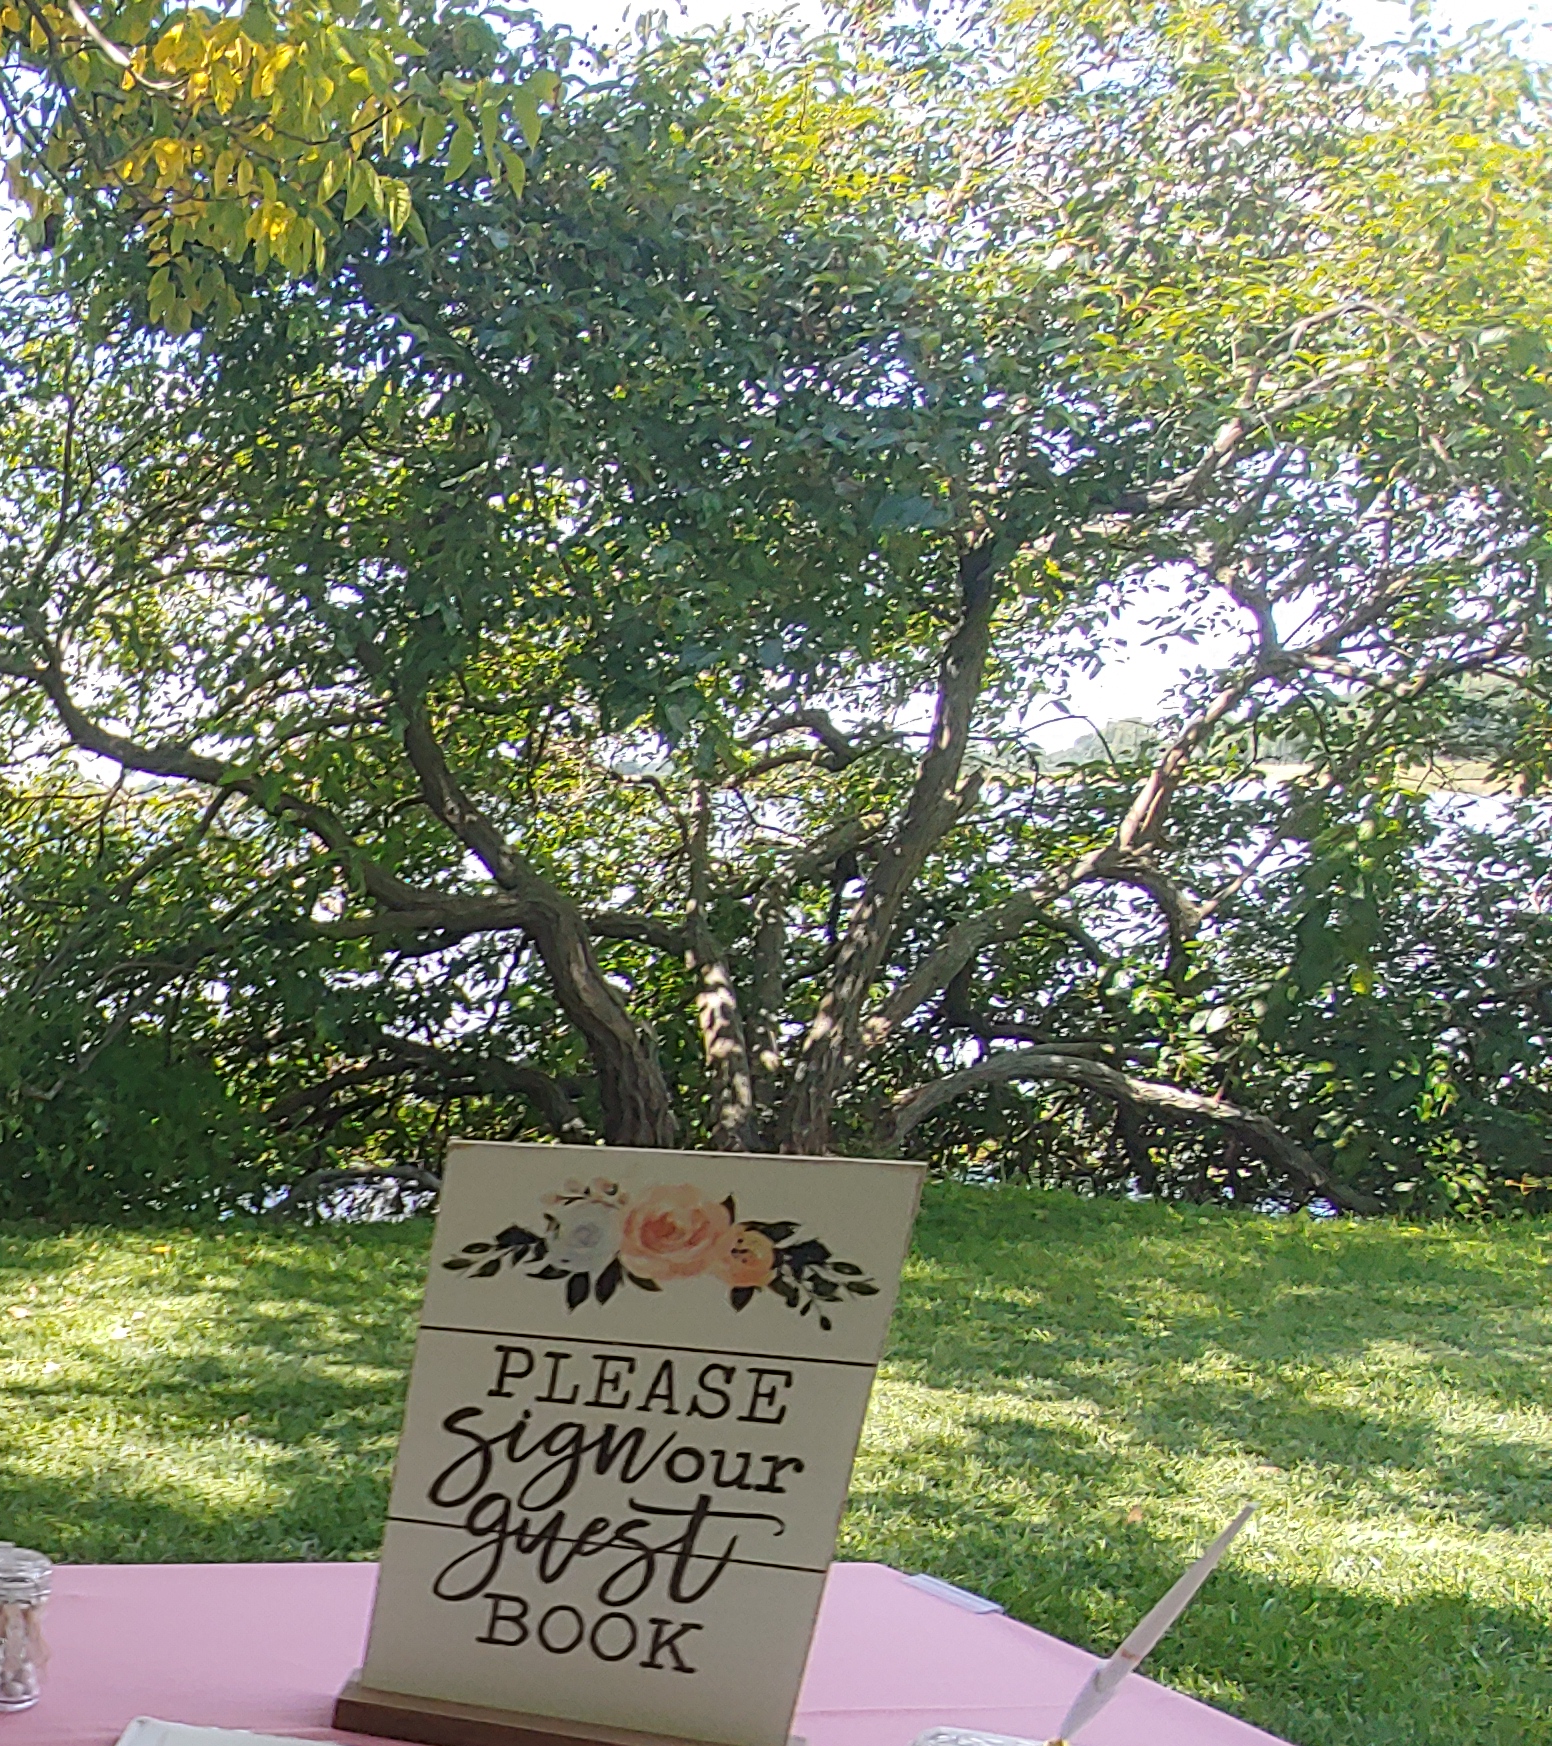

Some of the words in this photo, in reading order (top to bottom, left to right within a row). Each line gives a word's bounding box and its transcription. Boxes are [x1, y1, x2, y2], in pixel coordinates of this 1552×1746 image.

[487, 1345, 792, 1425] PLEASE
[665, 1447, 805, 1493] our
[433, 1492, 785, 1607] guest
[476, 1593, 704, 1674] BOOK
